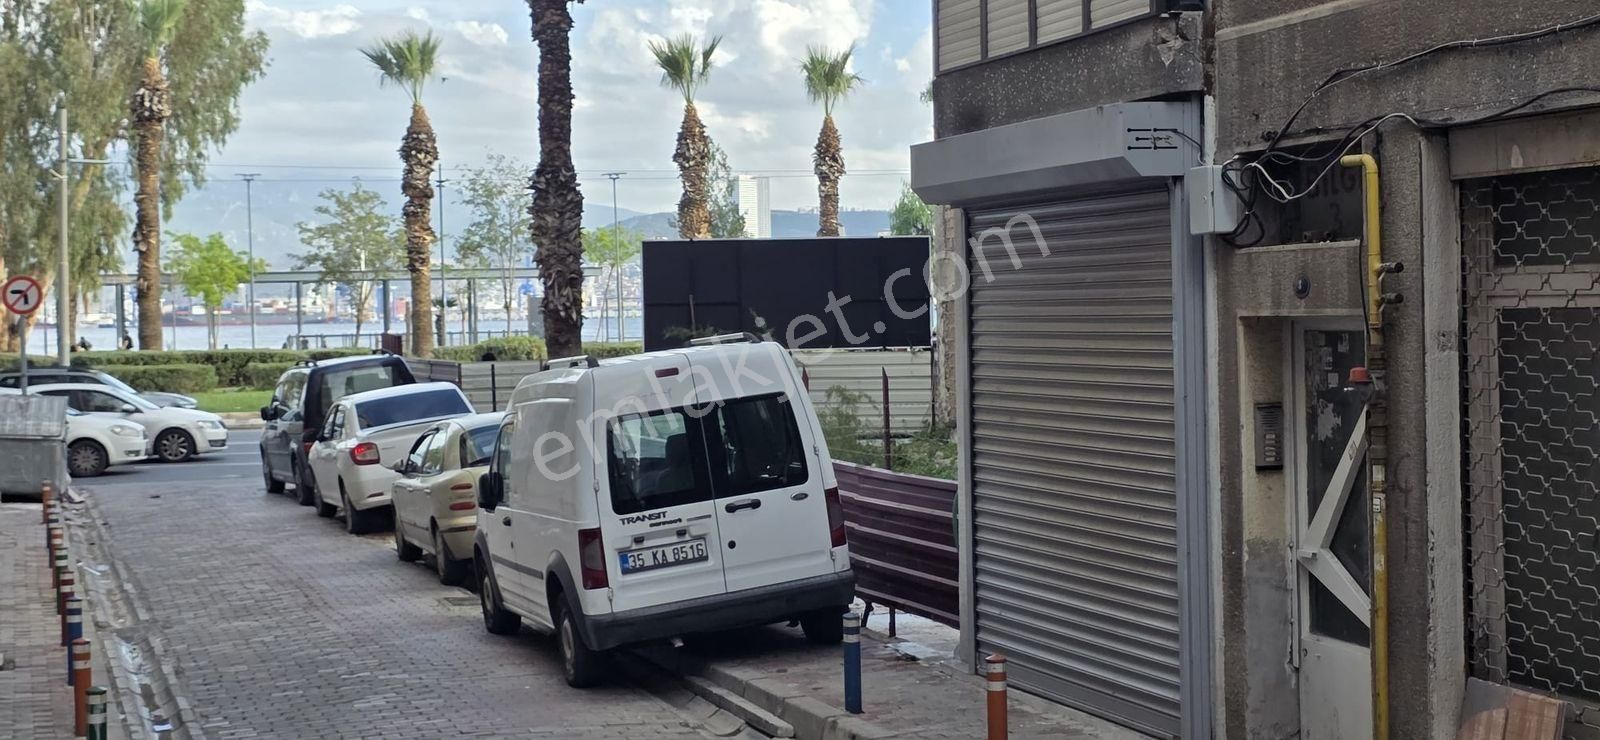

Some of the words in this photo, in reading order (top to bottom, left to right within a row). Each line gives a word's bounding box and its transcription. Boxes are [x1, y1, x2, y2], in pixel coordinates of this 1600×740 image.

[619, 511, 668, 526] TRANSIT
[628, 554, 646, 568] 35
[651, 549, 668, 566] KA
[672, 543, 704, 561] 8516
